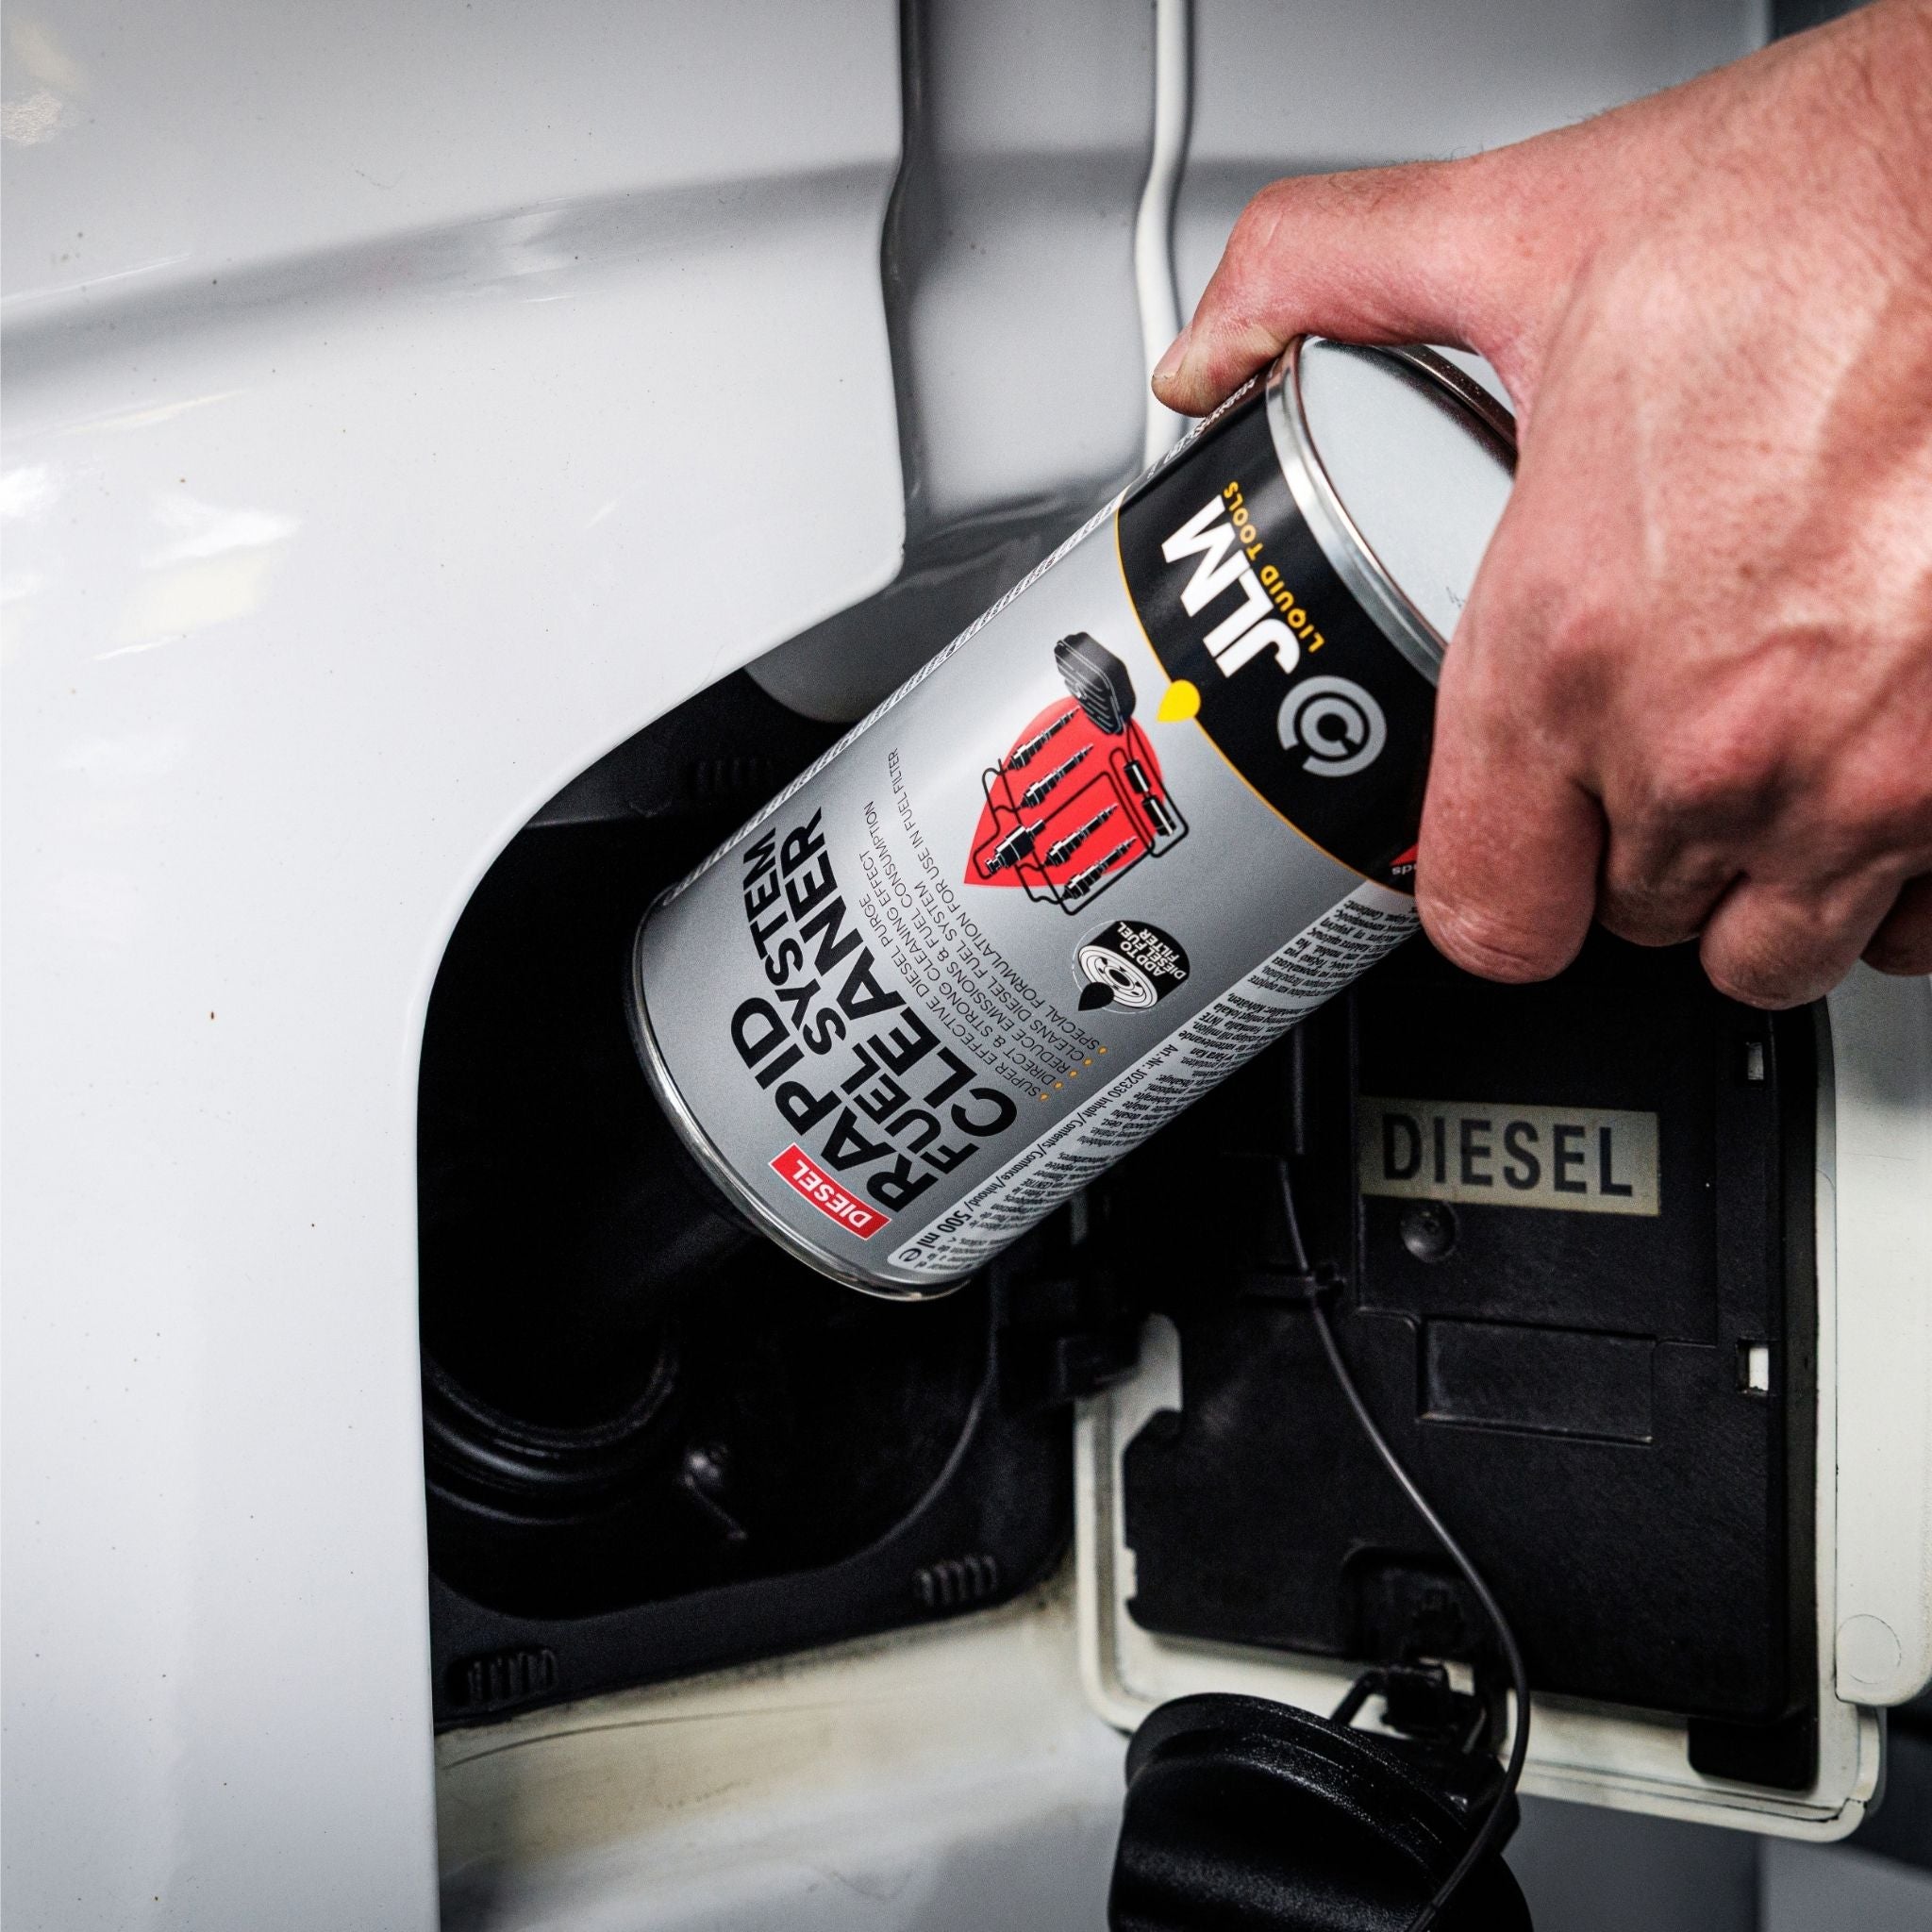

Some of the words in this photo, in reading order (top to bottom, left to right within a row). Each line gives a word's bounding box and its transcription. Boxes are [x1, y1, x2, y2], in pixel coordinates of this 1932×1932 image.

[1222, 481, 1264, 560] TOOLS
[1160, 492, 1299, 678] JLM
[1257, 562, 1326, 653] LIQUID
[886, 747, 904, 793] FILTER
[894, 790, 917, 830] FUEL
[862, 800, 913, 908] CONSUMPTION
[908, 829, 924, 847] IN
[858, 850, 891, 907] EFFECT
[917, 849, 941, 879] USE
[913, 879, 958, 941] SYSTEM
[934, 878, 960, 912] FOR
[741, 826, 847, 1050] SYSTEM
[858, 892, 893, 947] PURGE
[908, 907, 940, 948] FUEL
[1115, 921, 1146, 950] FUEL
[886, 906, 940, 981] CLEANING
[935, 947, 949, 961] &
[952, 939, 988, 979] FUEL
[955, 911, 1044, 1008] FORMULATION
[1118, 939, 1139, 958] TO
[1135, 953, 1166, 977] ADD
[1139, 927, 1179, 962] FILTER
[1143, 947, 1186, 979] DIESEL
[779, 806, 1017, 1137] CLEANER
[890, 944, 929, 997] DIESEL
[937, 980, 993, 1037] STRONG
[944, 960, 1014, 1031] EMISSIONS
[985, 975, 1032, 1022] DIESEL
[925, 995, 997, 1065] EFFECTIVE
[991, 1034, 1006, 1047] &
[1029, 1018, 1084, 1062] CLEANS
[1042, 1003, 1101, 1053] SPECIAL
[1003, 1048, 1056, 1086] DIRECT
[1011, 1029, 1070, 1074] REDUCE
[994, 1061, 1041, 1097] SUPER
[1106, 1066, 1147, 1100] J02330
[726, 1000, 938, 1213] RAPID
[840, 1042, 980, 1174] FUEL
[1381, 1113, 1632, 1197] DIESEL
[789, 1158, 873, 1227] DIESEL
[916, 1229, 938, 1250] ml
[937, 1207, 970, 1235] 500
